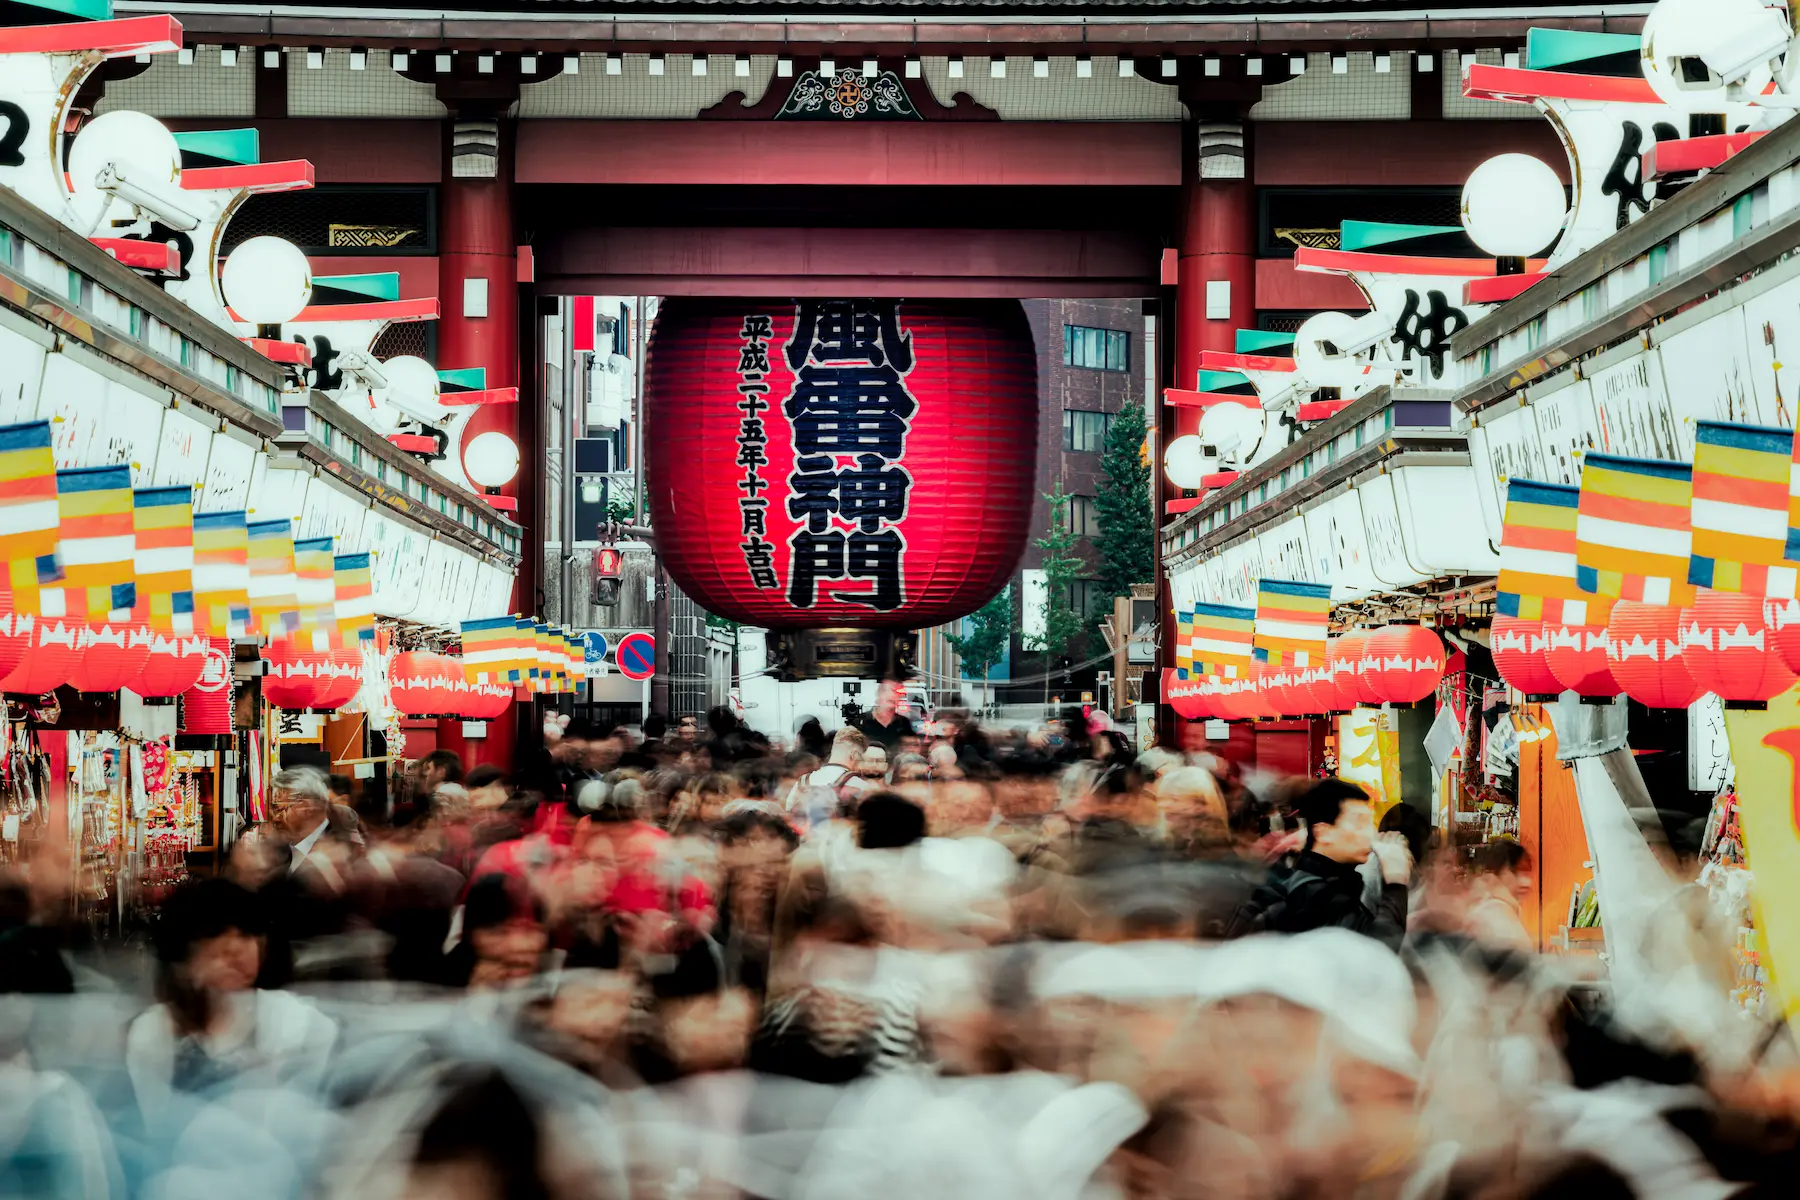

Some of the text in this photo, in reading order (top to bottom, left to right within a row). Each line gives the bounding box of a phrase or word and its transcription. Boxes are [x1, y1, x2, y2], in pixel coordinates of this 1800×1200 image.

[736, 315, 780, 589] 平成二十五年十一月吉日
[782, 298, 919, 612] 風雷神門
